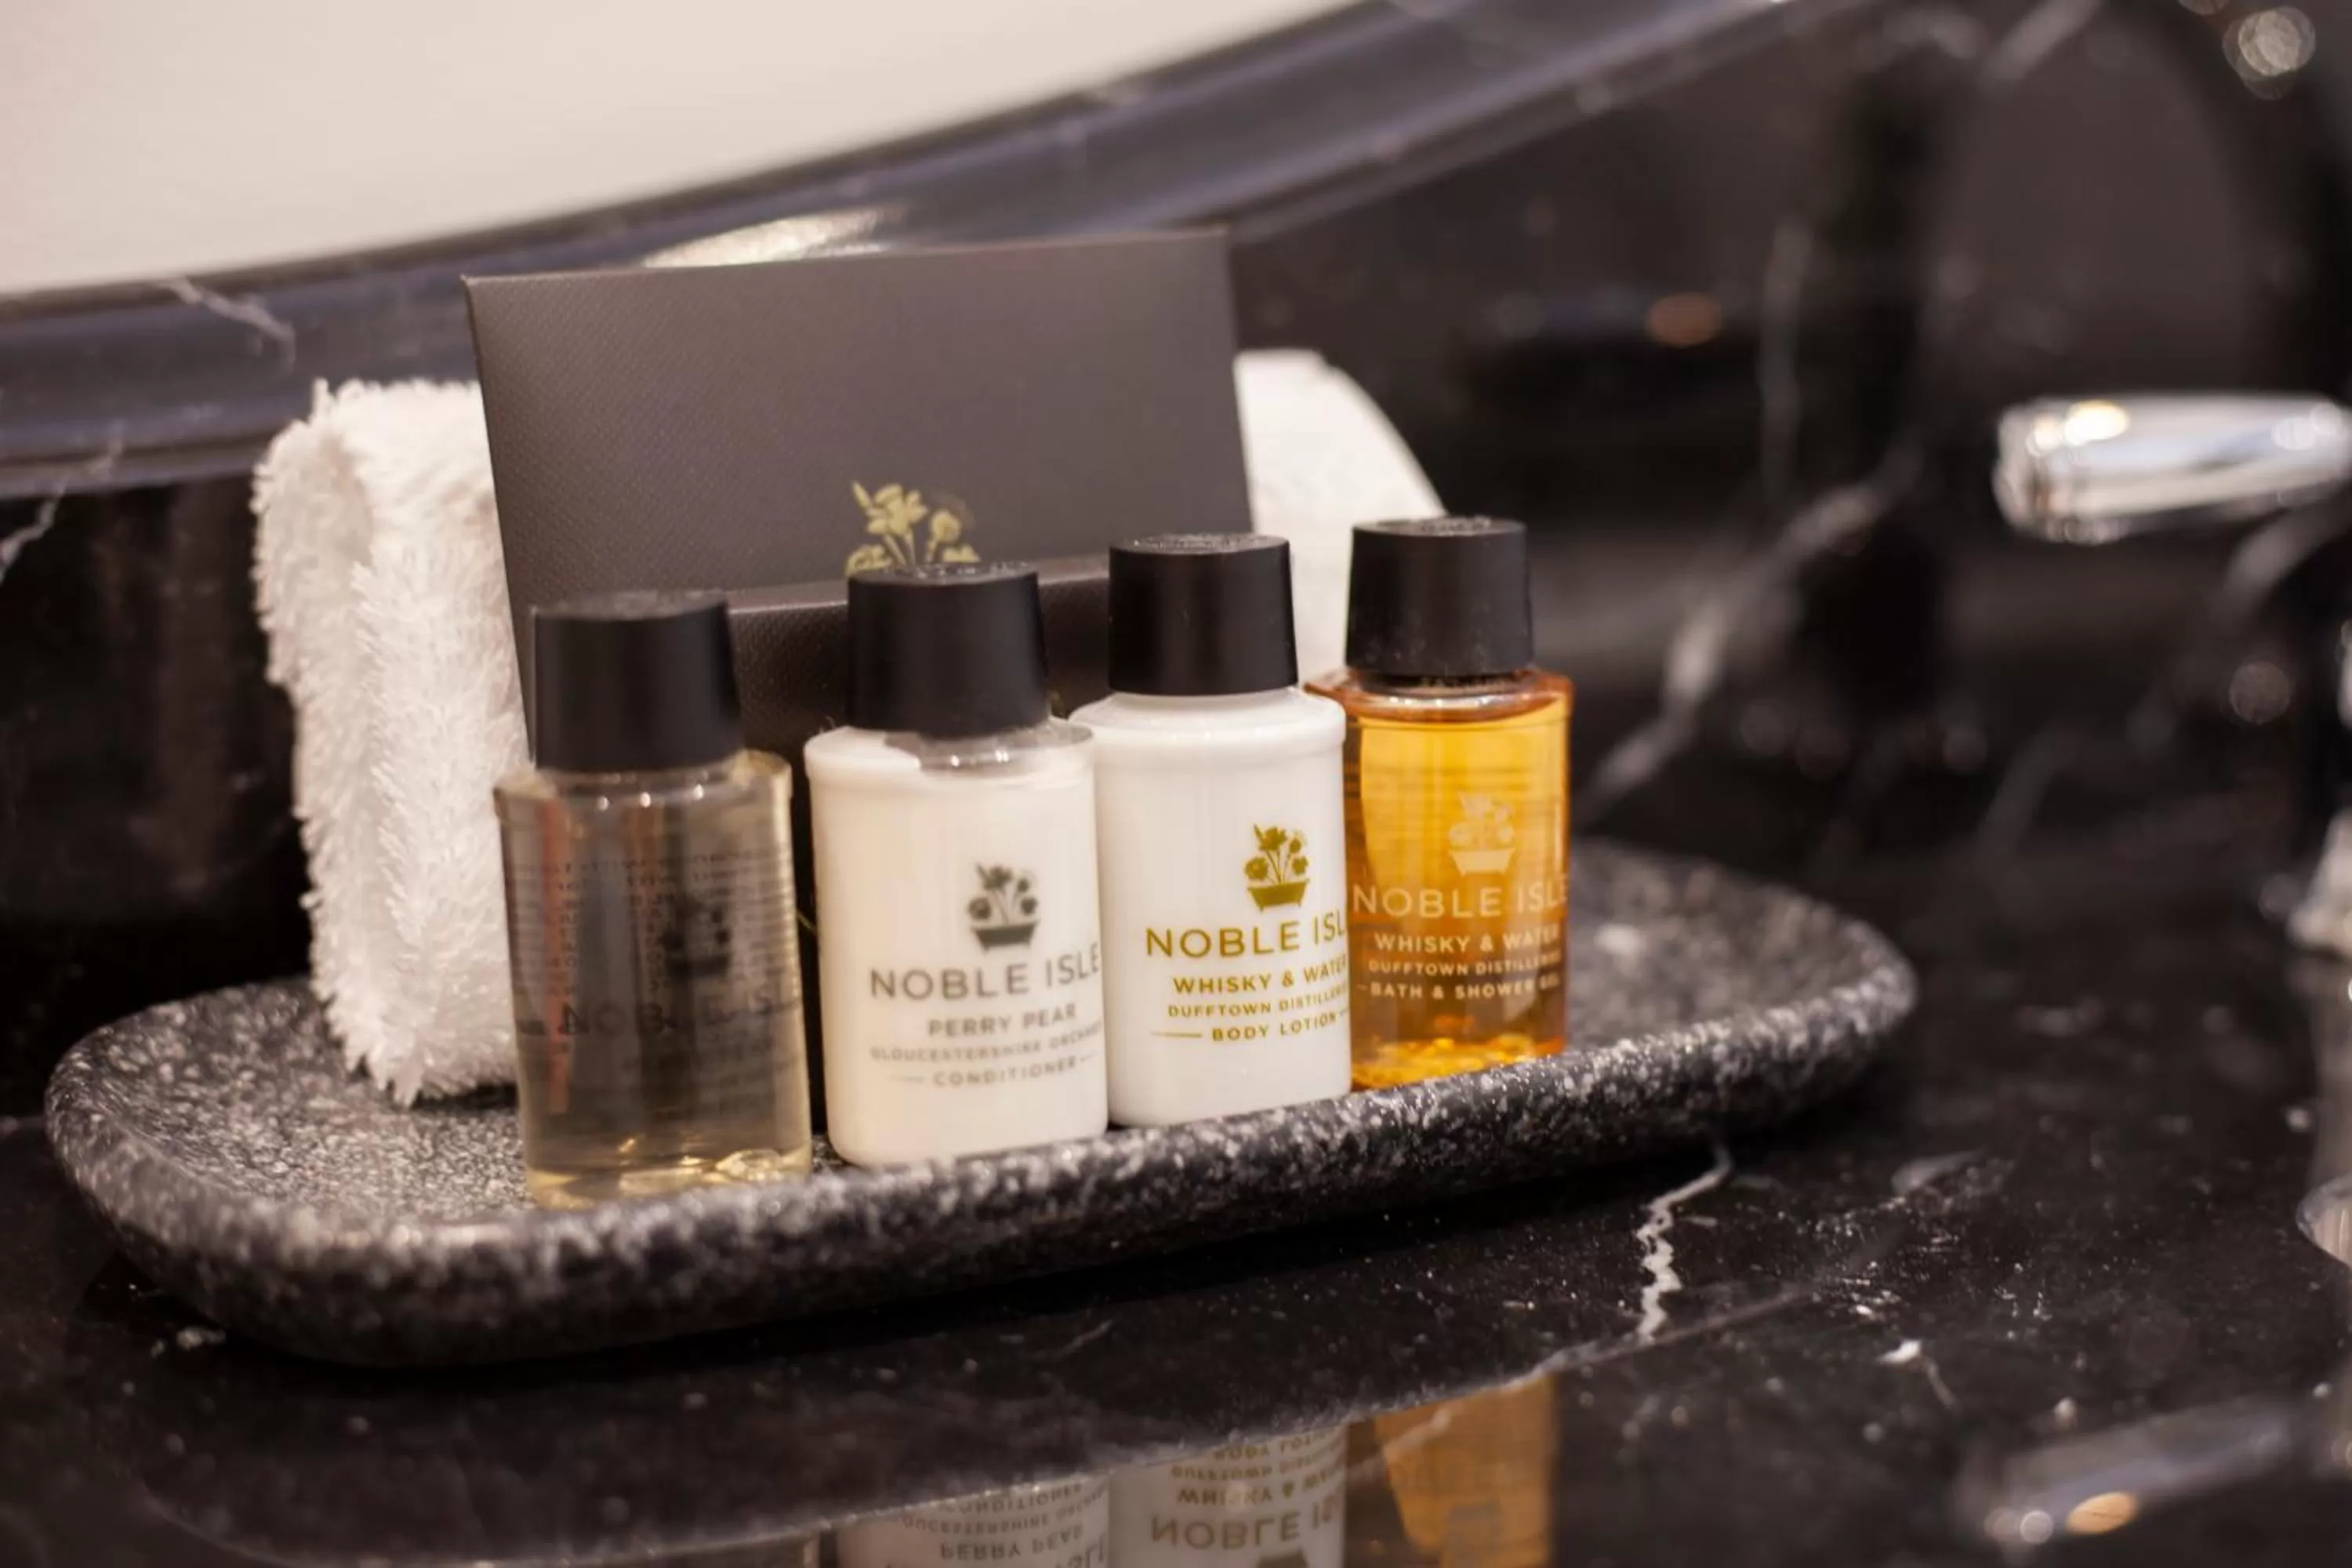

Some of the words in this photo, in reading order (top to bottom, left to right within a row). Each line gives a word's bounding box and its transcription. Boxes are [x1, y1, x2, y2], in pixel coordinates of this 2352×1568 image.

[1352, 884, 1501, 919] NOBLE
[1145, 920, 1299, 958] NOBLE
[1312, 909, 1345, 945] ISL
[1374, 933, 1470, 953] WHISKY
[1480, 934, 1494, 952] &
[869, 964, 1029, 1000] NOBLE
[1045, 942, 1099, 989] ISLE
[1173, 974, 1272, 994] WHISKY
[1282, 970, 1294, 987] &
[1369, 960, 1468, 976] DUFFTOWN
[1370, 981, 1422, 1000] BATH
[1432, 985, 1444, 1000] &
[1455, 976, 1535, 1000] SHOWER
[928, 1014, 1012, 1036] PERRY
[1023, 1004, 1076, 1029] PEAR
[1168, 1002, 1271, 1018] DUFFTOWN
[1212, 1025, 1269, 1041] BODY
[1280, 1011, 1337, 1036] LOTION
[933, 1054, 1076, 1087] CONDITIONER
